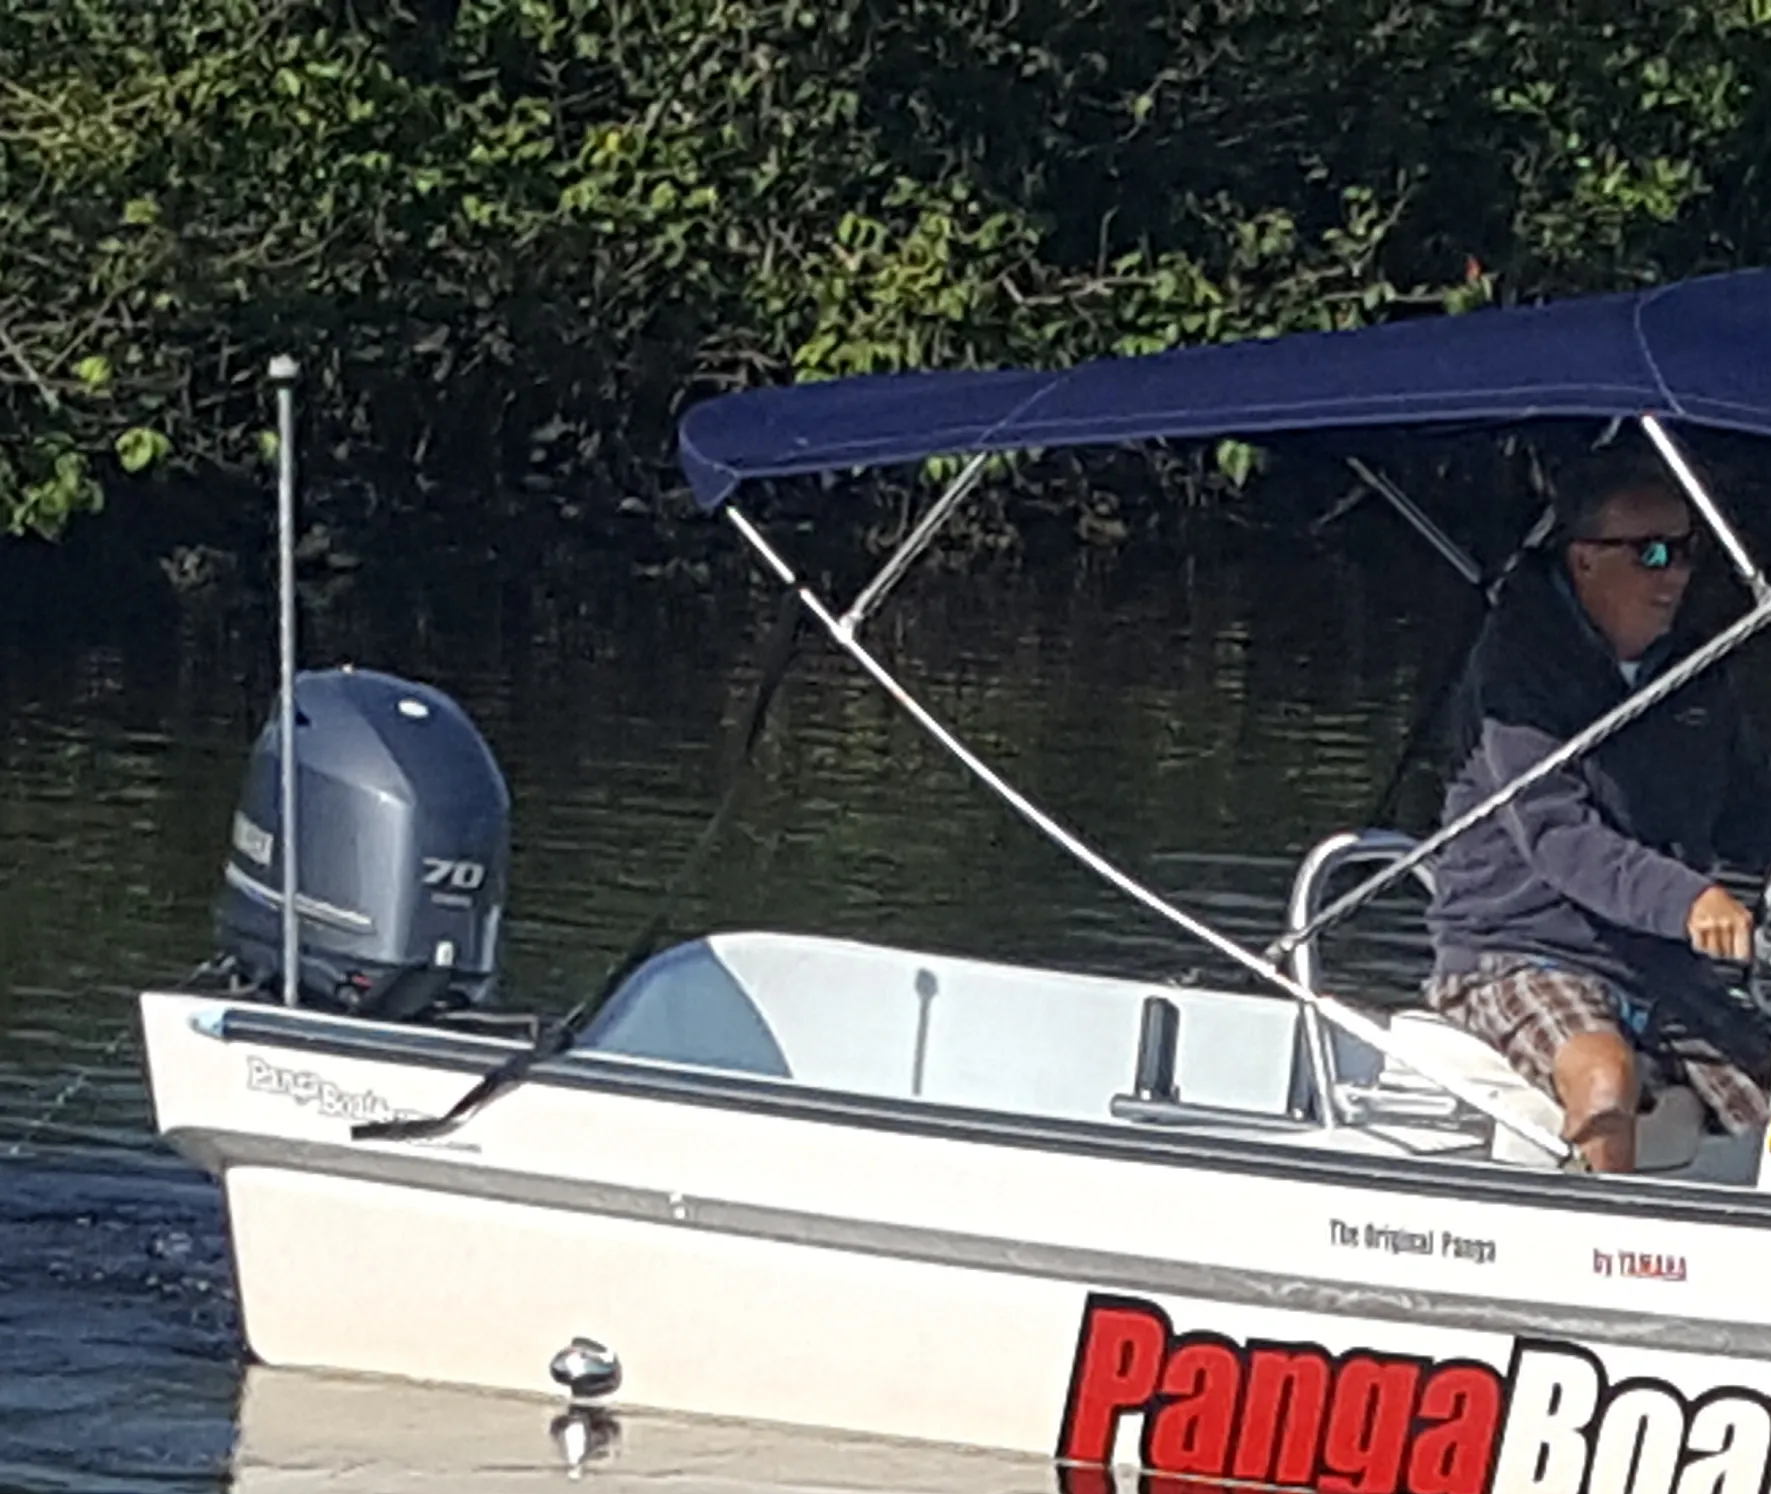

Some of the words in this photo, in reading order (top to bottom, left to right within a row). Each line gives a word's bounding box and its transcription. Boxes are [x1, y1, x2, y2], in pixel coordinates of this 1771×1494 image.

[422, 857, 485, 889] 70
[1329, 1217, 1359, 1248] The
[1364, 1222, 1434, 1256] Original
[1593, 1247, 1613, 1278] by
